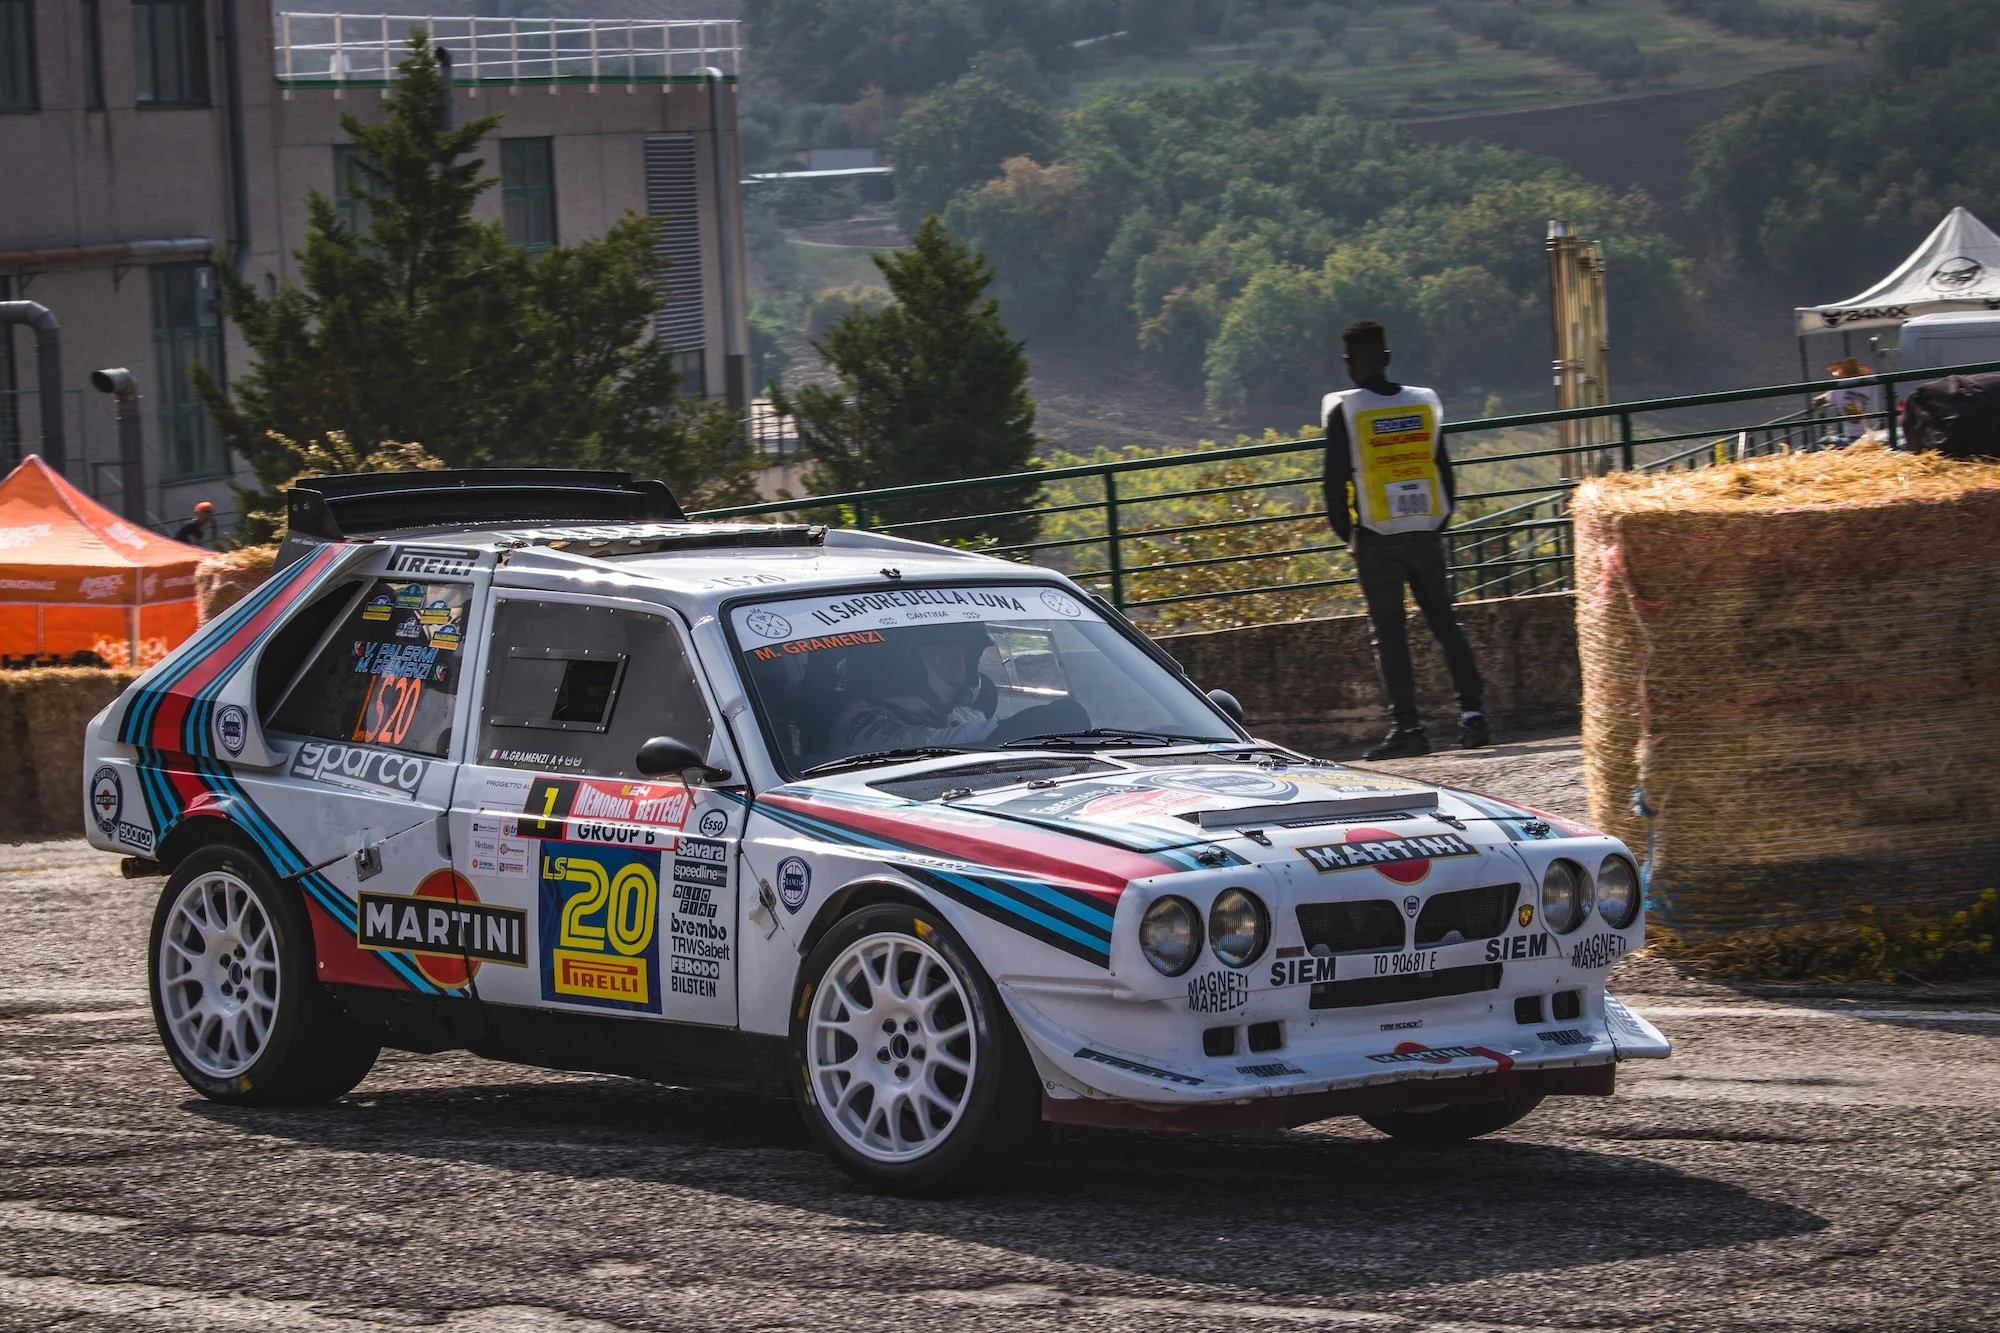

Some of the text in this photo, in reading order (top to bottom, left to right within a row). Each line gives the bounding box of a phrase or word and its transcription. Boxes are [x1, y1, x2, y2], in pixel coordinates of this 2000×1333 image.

[386, 545, 481, 577] PIRELLI
[812, 589, 1027, 626] IL SAPORE DELLA LUNA
[906, 610, 950, 620] CANTINA
[364, 641, 440, 663] V. PALERMI
[754, 631, 886, 661] M. GRAMENZI
[354, 656, 432, 680] M. GRAMENZI
[301, 742, 423, 790] sparco
[485, 779, 522, 789] PROGETTO
[536, 787, 560, 830] 1
[573, 782, 689, 824] MEMORIAL BETTEGA
[120, 823, 151, 846] sparco
[577, 820, 656, 846] GROUP B
[677, 837, 725, 861] Savara
[1305, 835, 1470, 869] MARTINI
[543, 855, 568, 881] LS
[674, 864, 718, 881] speedline
[674, 885, 711, 901] OLIO
[560, 857, 657, 956] 20
[680, 901, 717, 918] FIAT
[365, 901, 520, 955] MARTINI
[671, 912, 727, 941] brembo
[1485, 933, 1548, 962] SIEM
[1573, 933, 1627, 957] MAGNETI
[561, 957, 640, 993] PIRELLI
[671, 955, 719, 978] FERODO
[1270, 957, 1337, 987] SIEM
[1374, 951, 1438, 975] TO 90681 E
[671, 975, 717, 998] BILSTEIN
[1188, 971, 1249, 996] MAGNETI
[1188, 990, 1249, 1014] MARELLI
[1374, 1047, 1472, 1063] MARTINI
